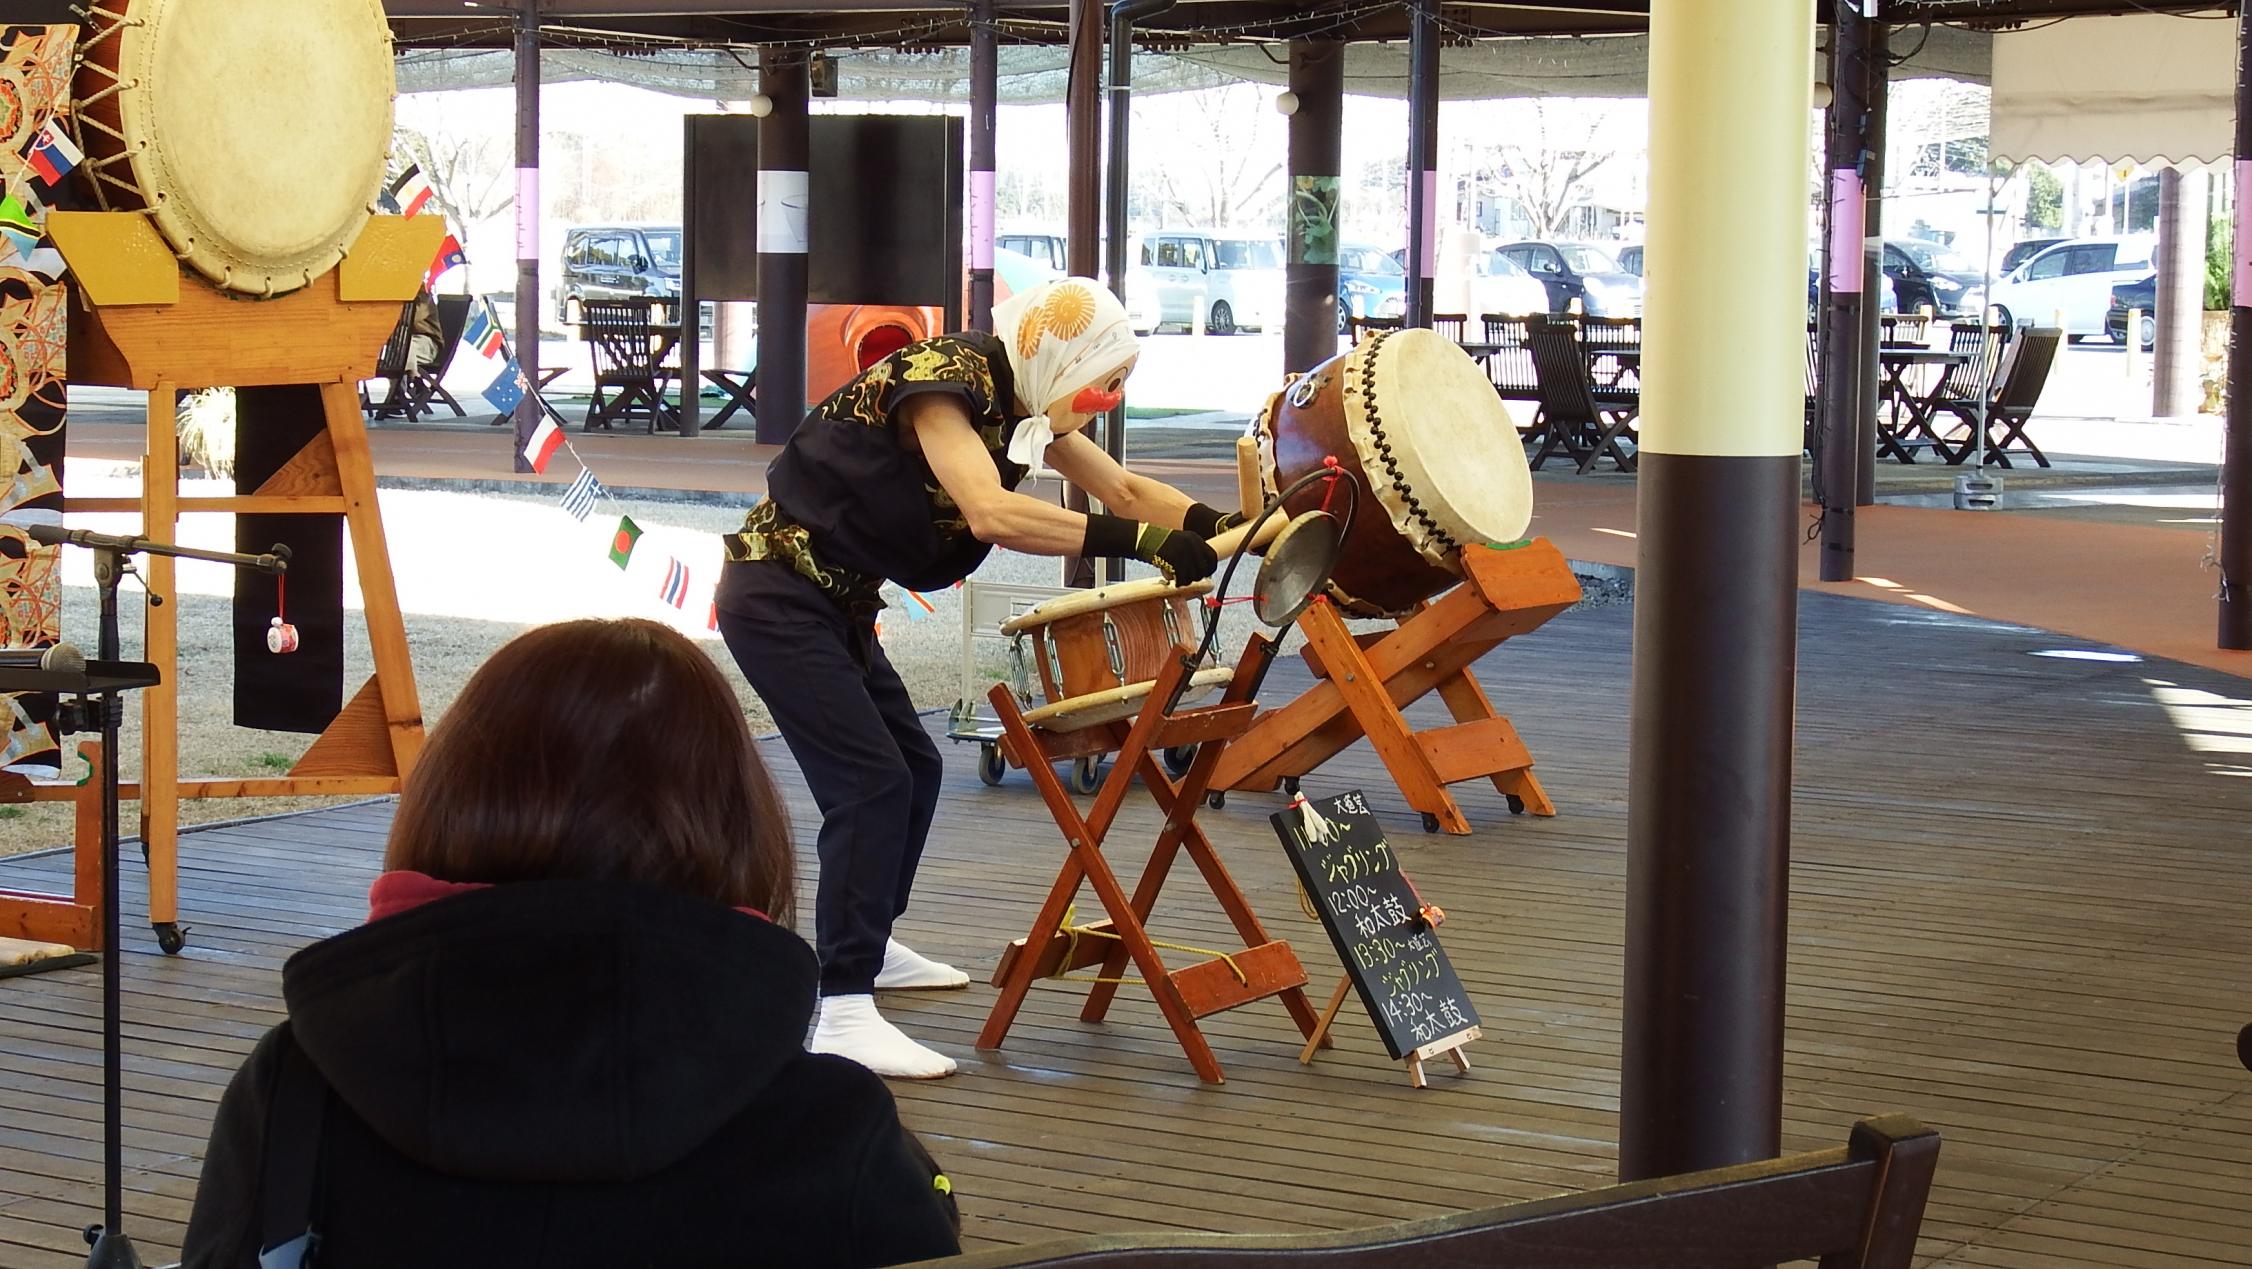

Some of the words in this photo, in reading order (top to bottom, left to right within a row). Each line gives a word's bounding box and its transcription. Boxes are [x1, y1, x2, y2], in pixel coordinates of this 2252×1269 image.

[1321, 839, 1390, 884] ジャグリング
[1356, 893, 1412, 938] 和太鼓
[1382, 948, 1439, 997] ジャグリング
[1411, 997, 1469, 1042] 和太鼓
